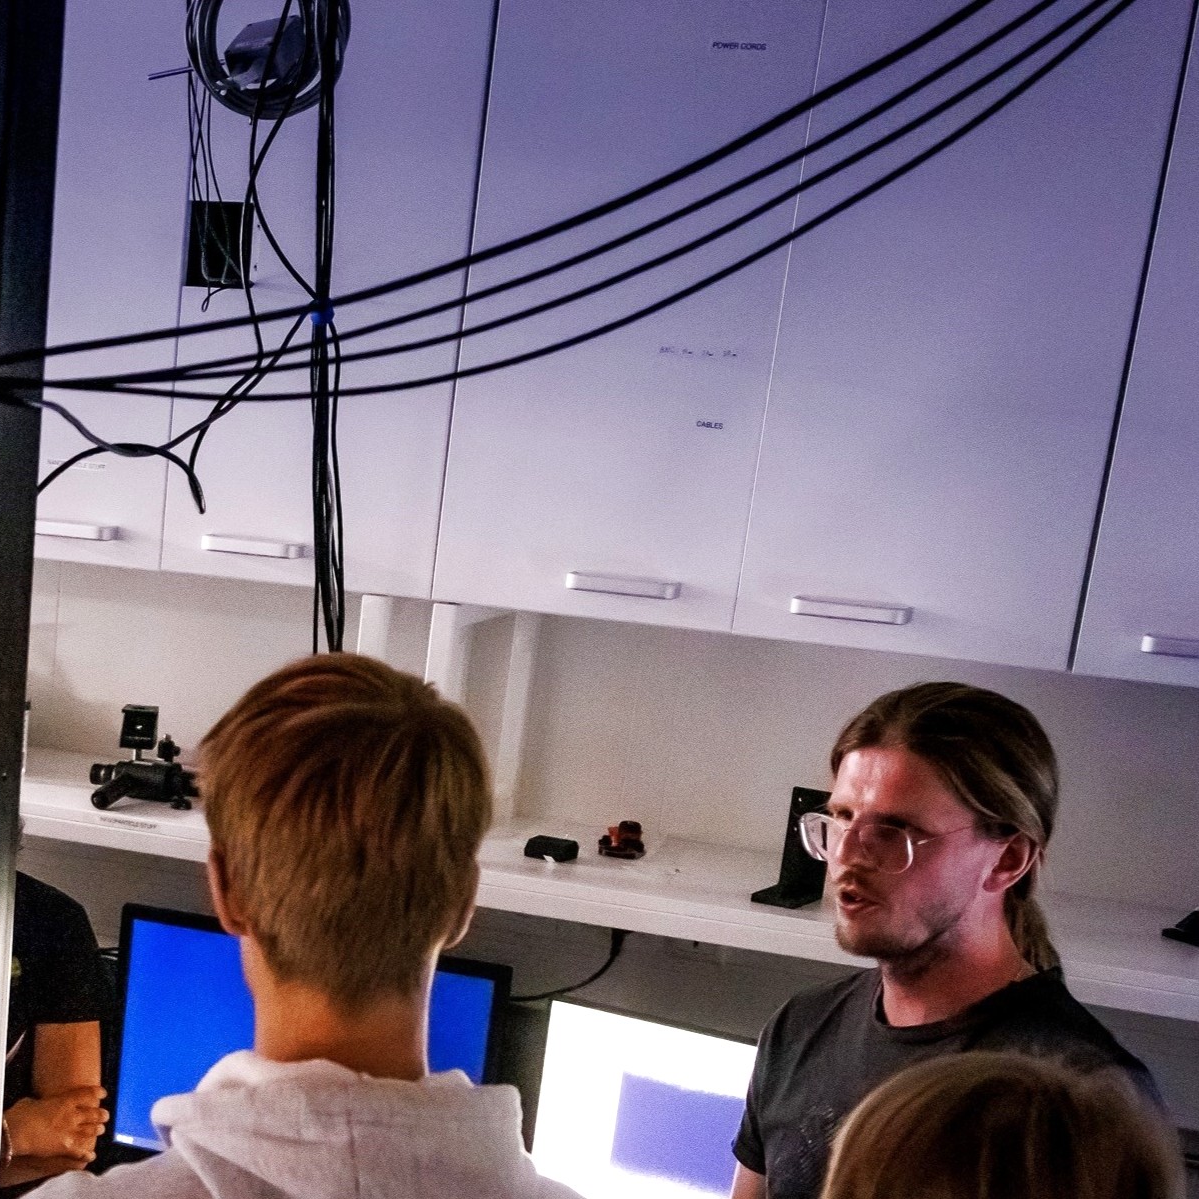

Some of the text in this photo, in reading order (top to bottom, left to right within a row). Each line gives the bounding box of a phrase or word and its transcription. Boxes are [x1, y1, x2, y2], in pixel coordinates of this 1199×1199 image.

[712, 41, 767, 51] POWER CORDS
[696, 420, 724, 430] CABLES
